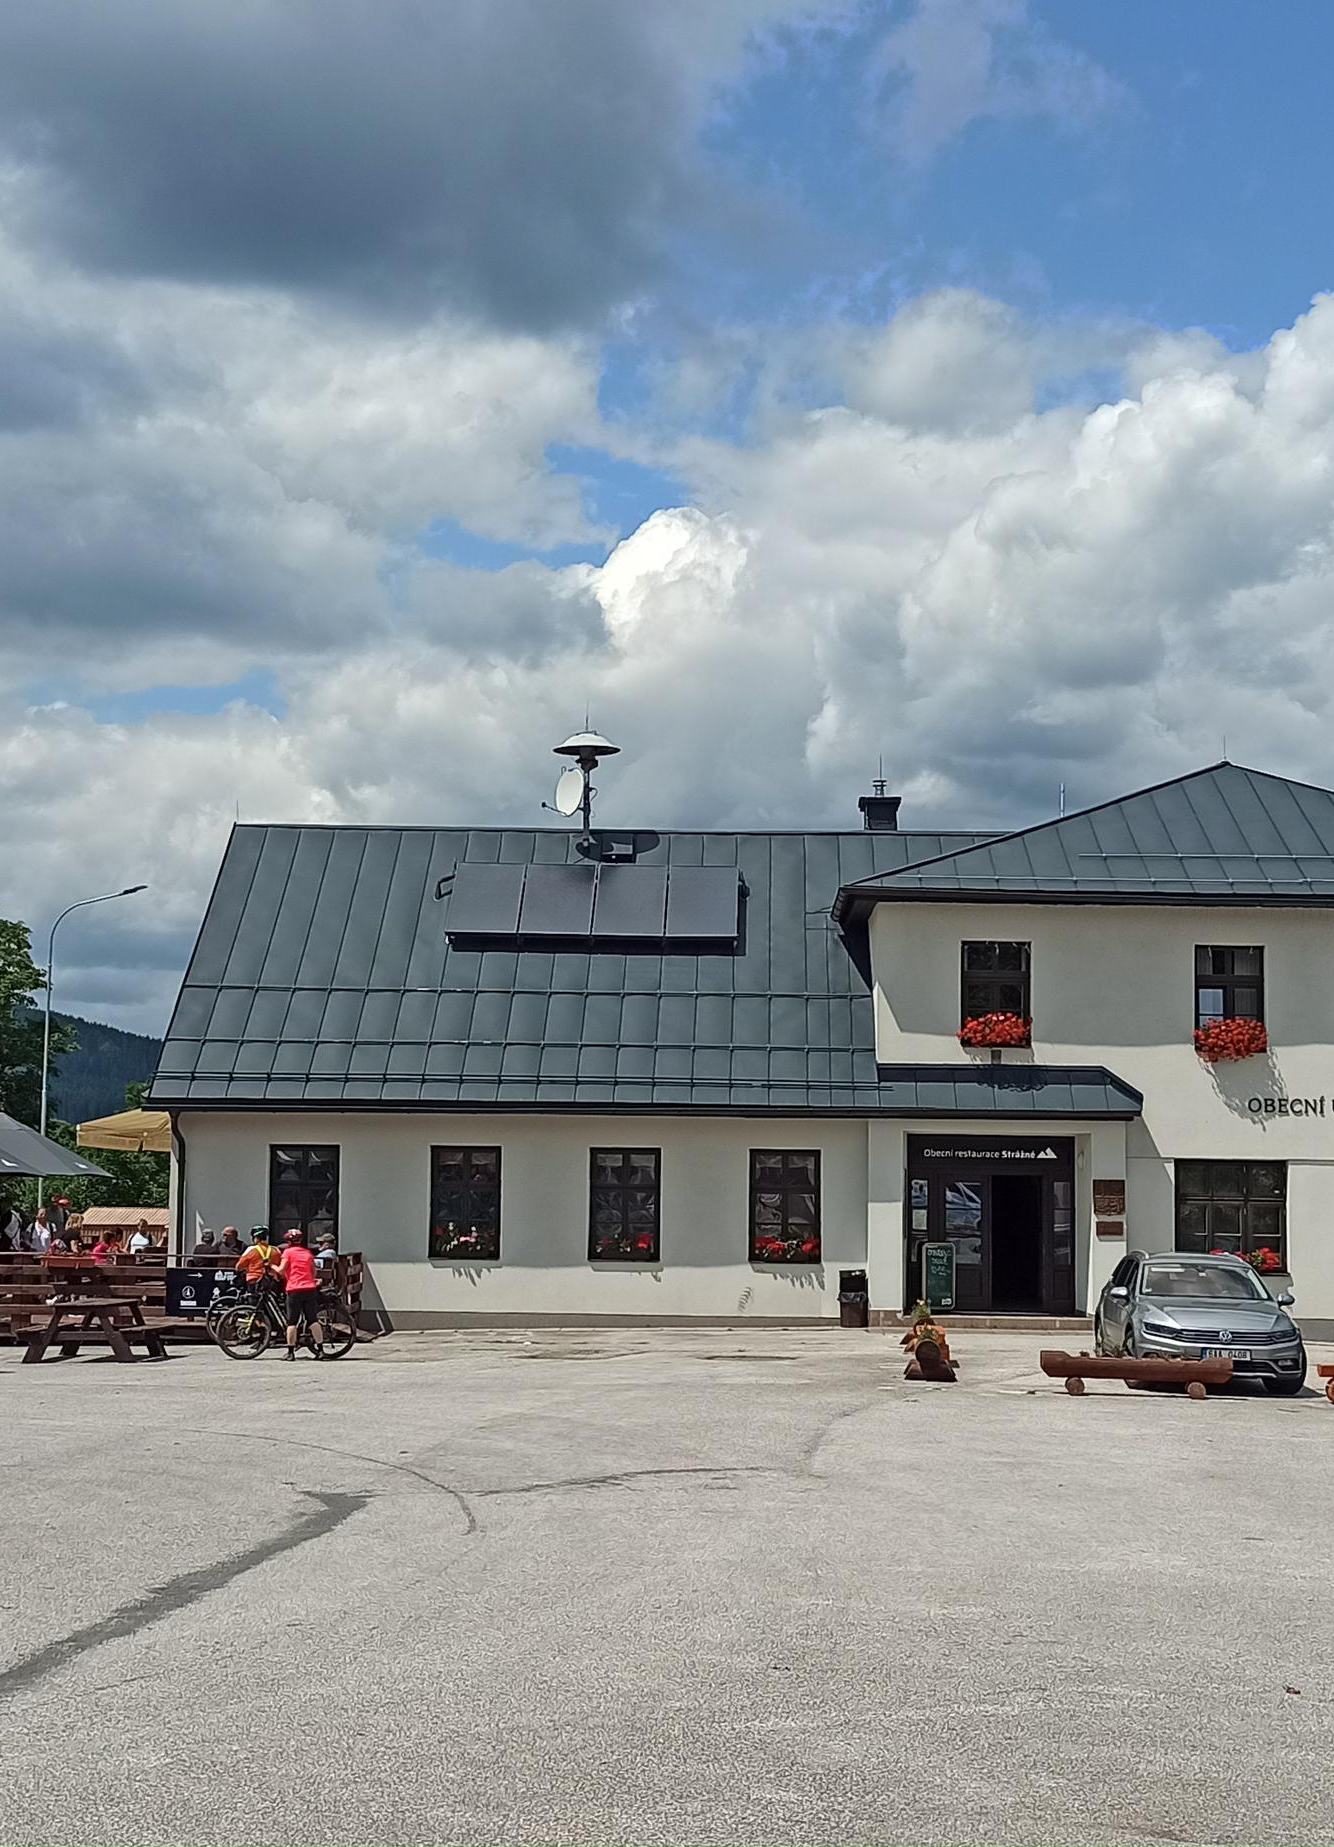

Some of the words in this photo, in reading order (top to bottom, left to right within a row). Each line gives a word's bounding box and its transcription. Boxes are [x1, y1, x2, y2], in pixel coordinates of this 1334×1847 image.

[1247, 1095, 1326, 1115] OBECNÍ
[923, 1148, 954, 1158] Obecní
[955, 1150, 1000, 1159] restaurace
[1001, 1150, 1036, 1159] Strážné
